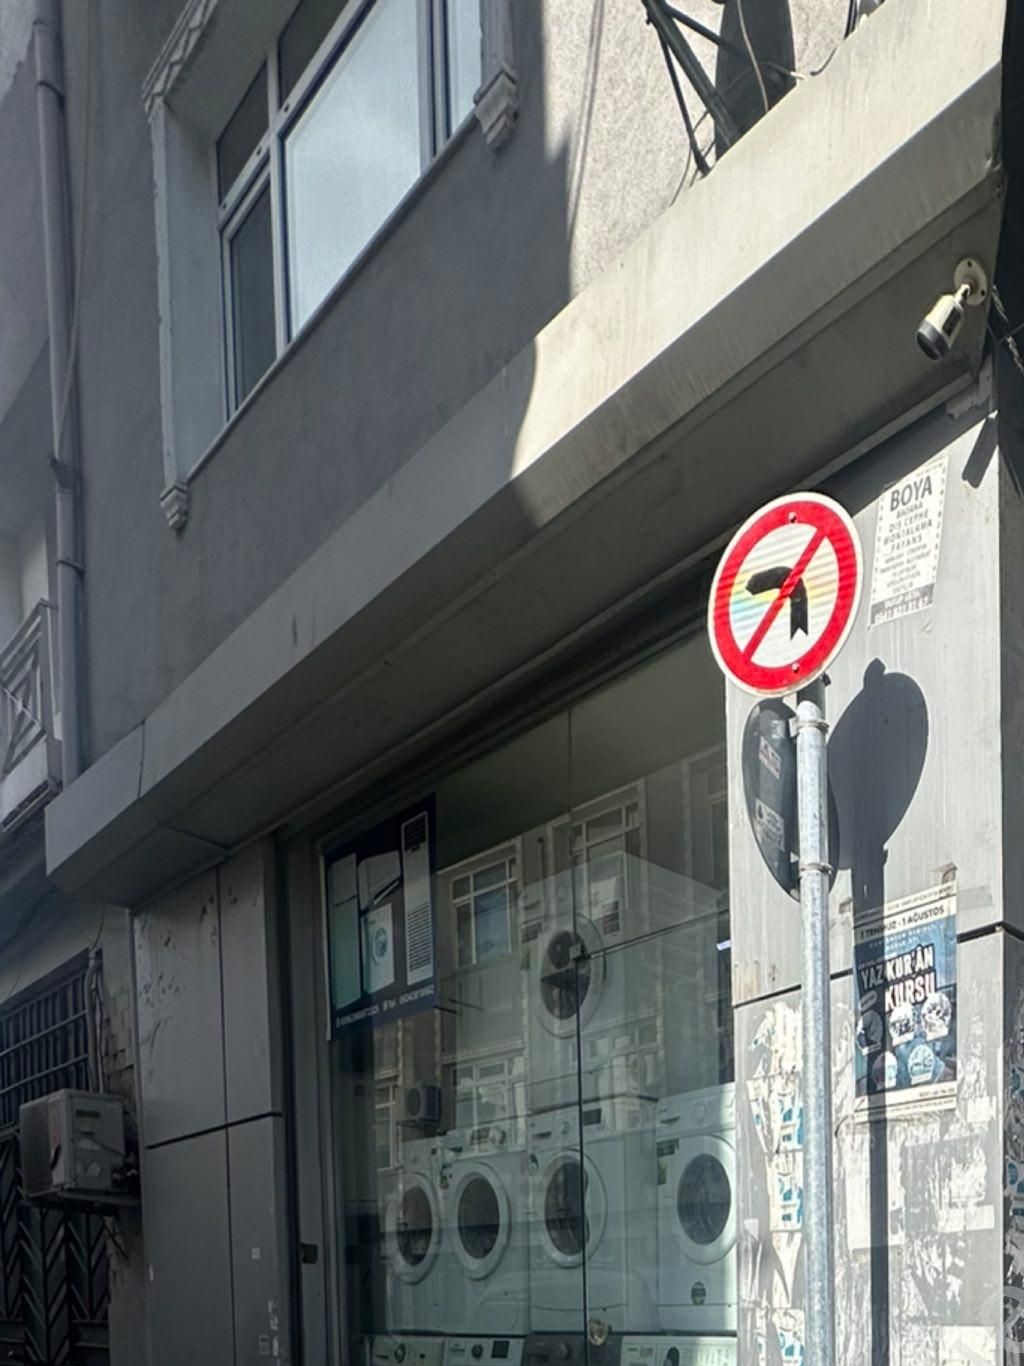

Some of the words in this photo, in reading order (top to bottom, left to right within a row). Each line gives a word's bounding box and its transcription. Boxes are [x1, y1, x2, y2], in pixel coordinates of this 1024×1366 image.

[890, 475, 933, 512] BOYA
[861, 962, 884, 989] YAZ
[884, 971, 936, 1013] KURSU
